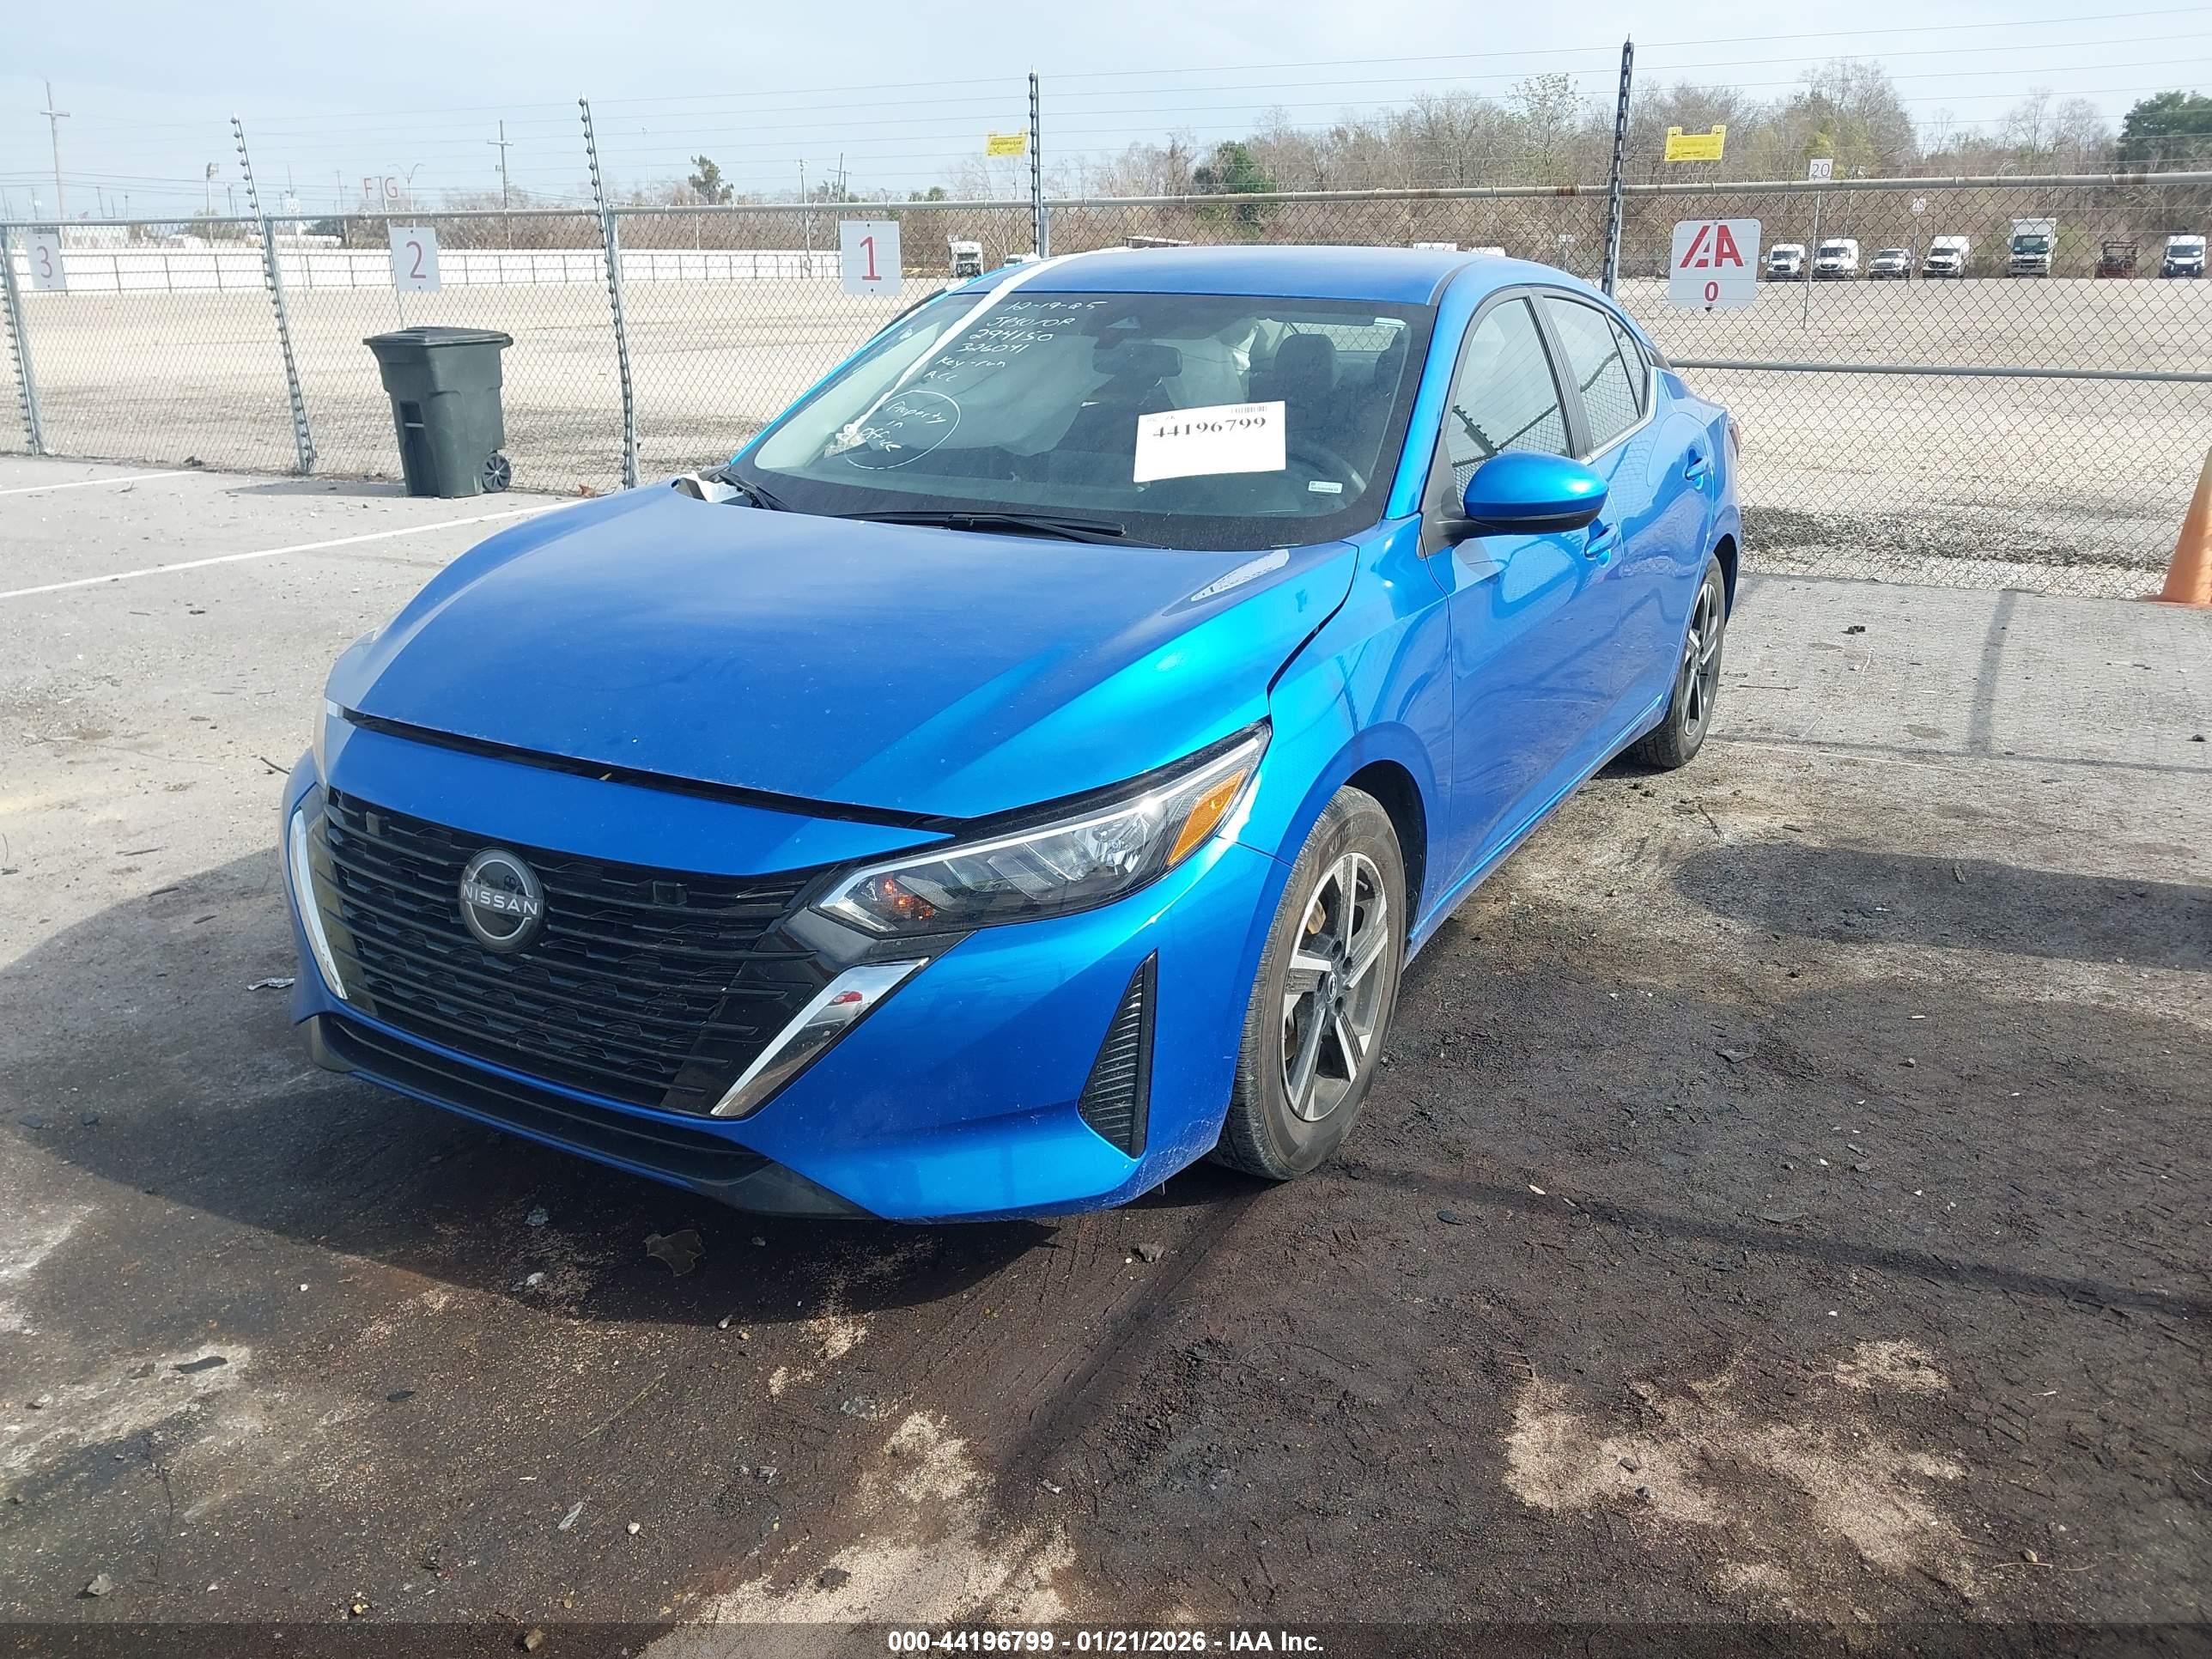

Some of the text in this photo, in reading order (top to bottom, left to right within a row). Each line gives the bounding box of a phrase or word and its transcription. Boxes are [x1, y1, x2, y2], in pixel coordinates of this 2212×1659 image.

[1811, 164, 1830, 177] 20
[37, 246, 52, 279] 3
[406, 240, 427, 278] 2
[860, 236, 882, 281] 1
[1705, 282, 1718, 301] 0
[1152, 416, 1267, 438] 44196799
[462, 883, 538, 915] NISSAN
